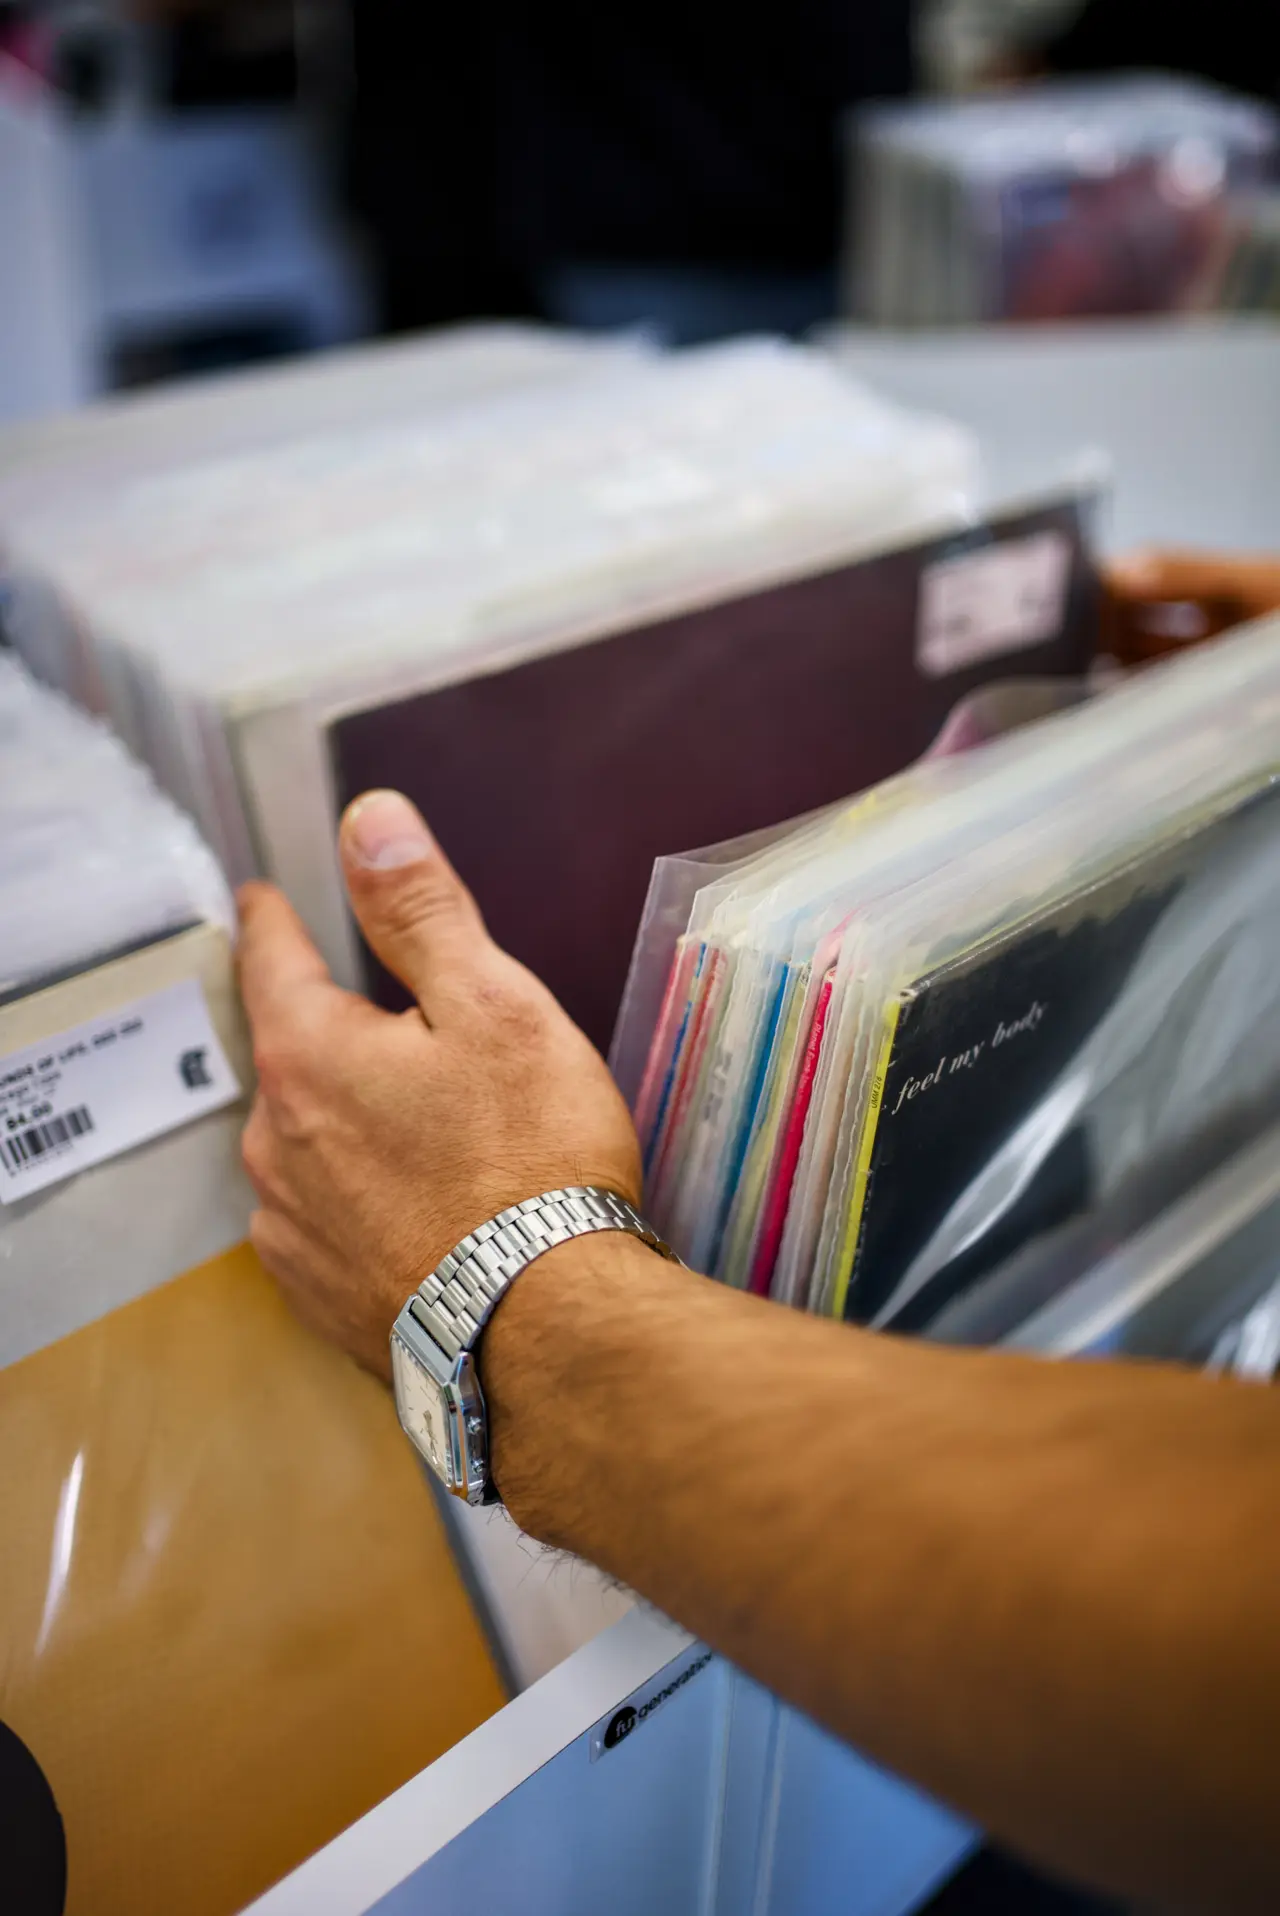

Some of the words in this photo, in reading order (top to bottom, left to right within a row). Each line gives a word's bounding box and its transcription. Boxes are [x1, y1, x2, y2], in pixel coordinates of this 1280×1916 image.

[891, 1056, 947, 1115] feel
[949, 1040, 986, 1075] my
[990, 1000, 1048, 1048] body
[871, 1089, 880, 1109] UMM
[637, 1651, 713, 1720] generatio
